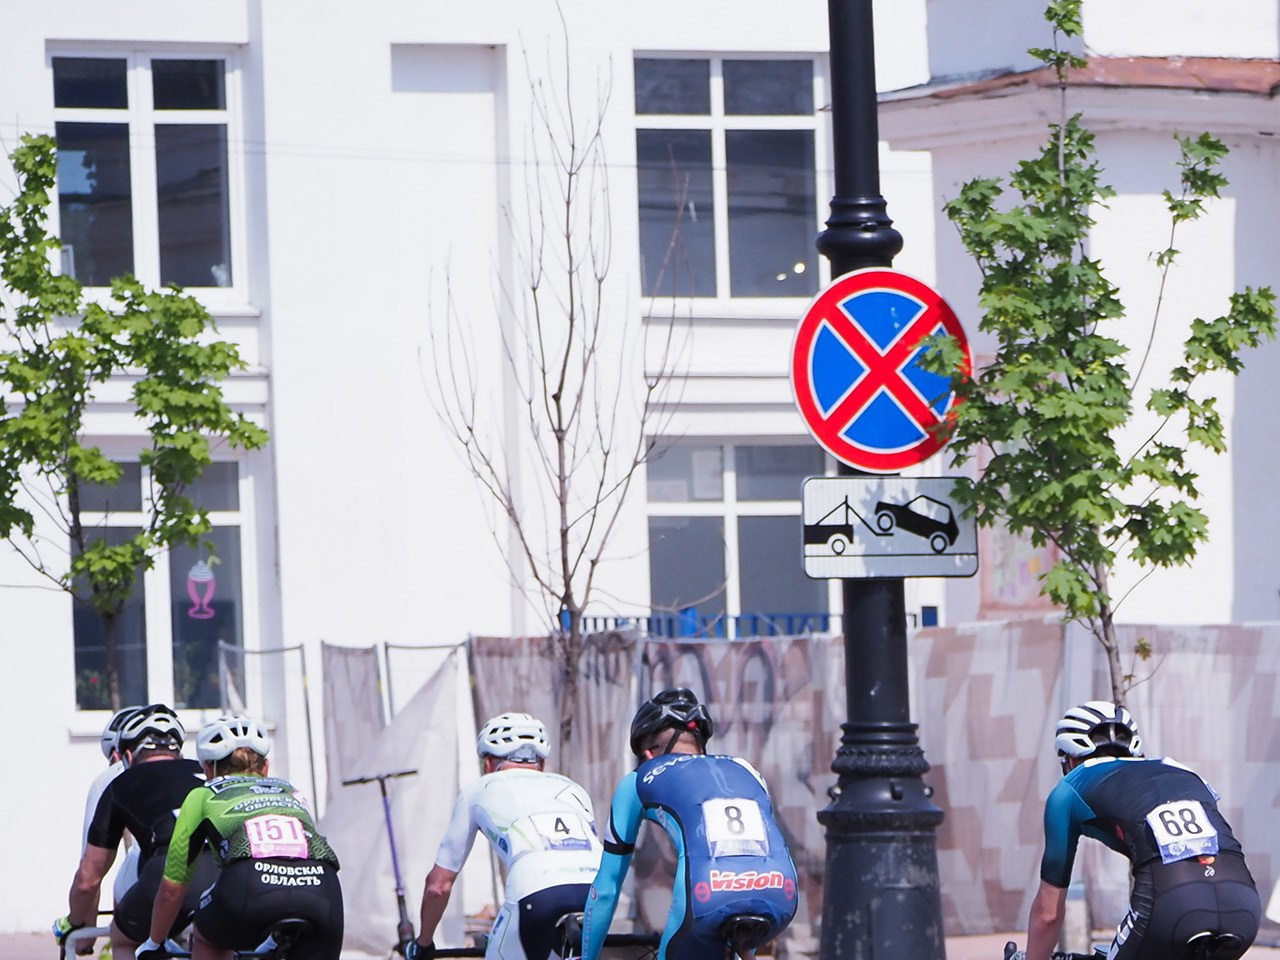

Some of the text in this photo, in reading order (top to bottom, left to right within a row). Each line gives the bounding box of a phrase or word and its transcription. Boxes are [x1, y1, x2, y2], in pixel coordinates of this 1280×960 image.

[253, 818, 299, 842] 151
[554, 817, 571, 835] 4
[724, 805, 745, 836] 8
[1158, 807, 1203, 836] 68
[254, 861, 325, 876] ОРЛОВСКАЯ
[260, 873, 322, 887] ОБЛАСТЬ
